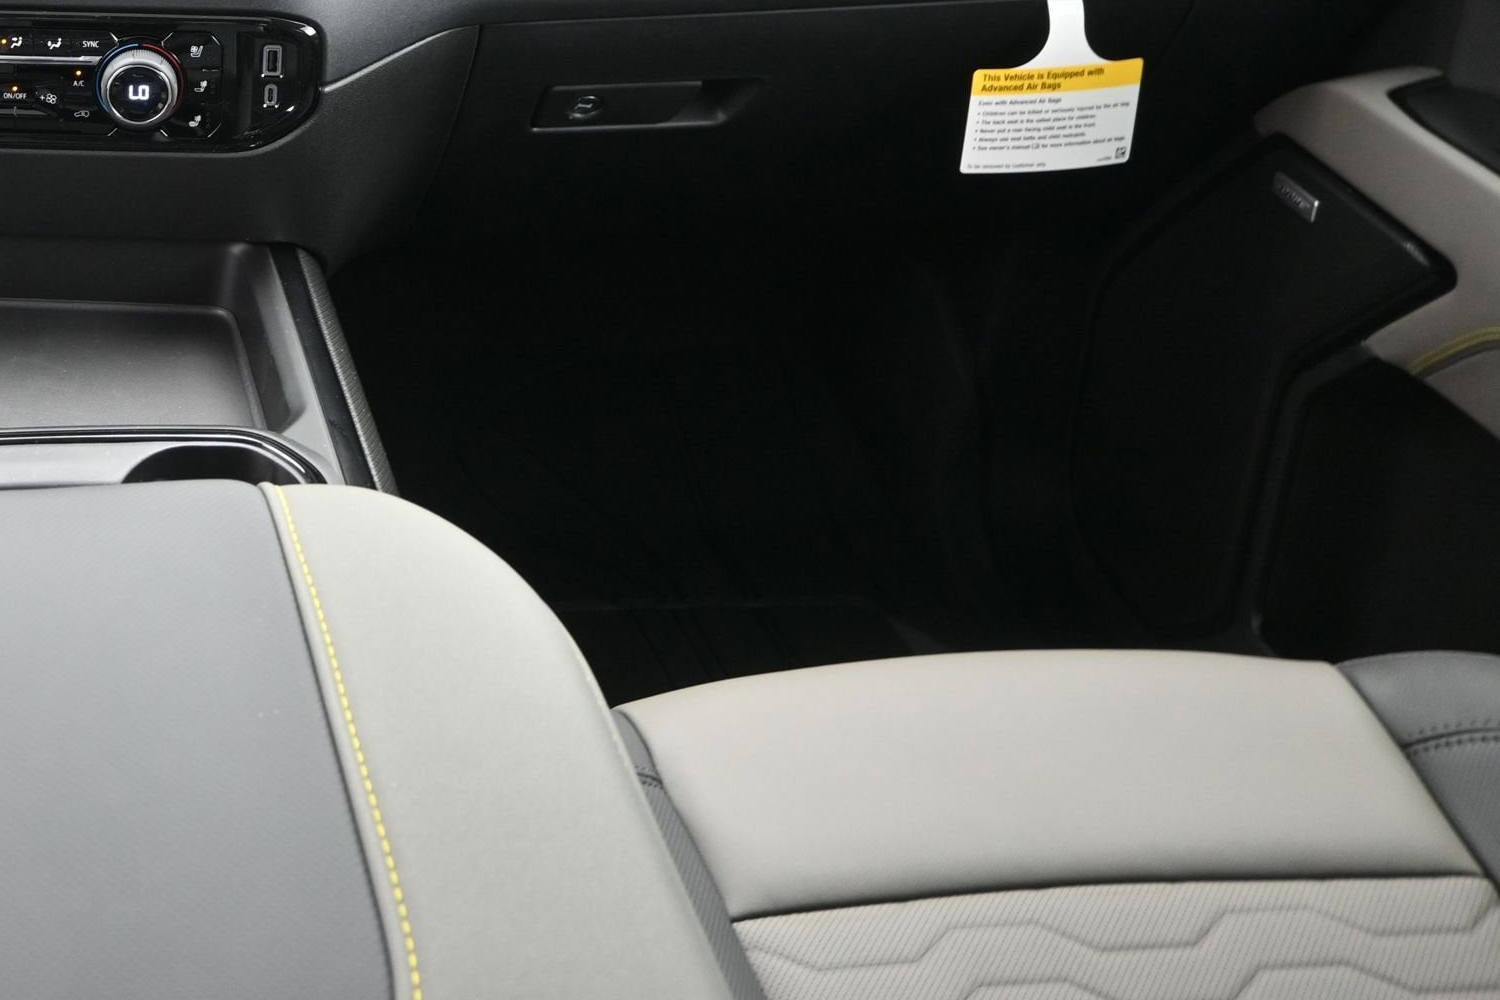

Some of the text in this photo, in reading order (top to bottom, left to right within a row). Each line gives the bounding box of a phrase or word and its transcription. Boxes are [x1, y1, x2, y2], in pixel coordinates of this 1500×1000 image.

[983, 68, 1104, 82] This Vehicle is Equipped with
[981, 83, 1024, 92] Advanced
[1041, 82, 1061, 91] Bags
